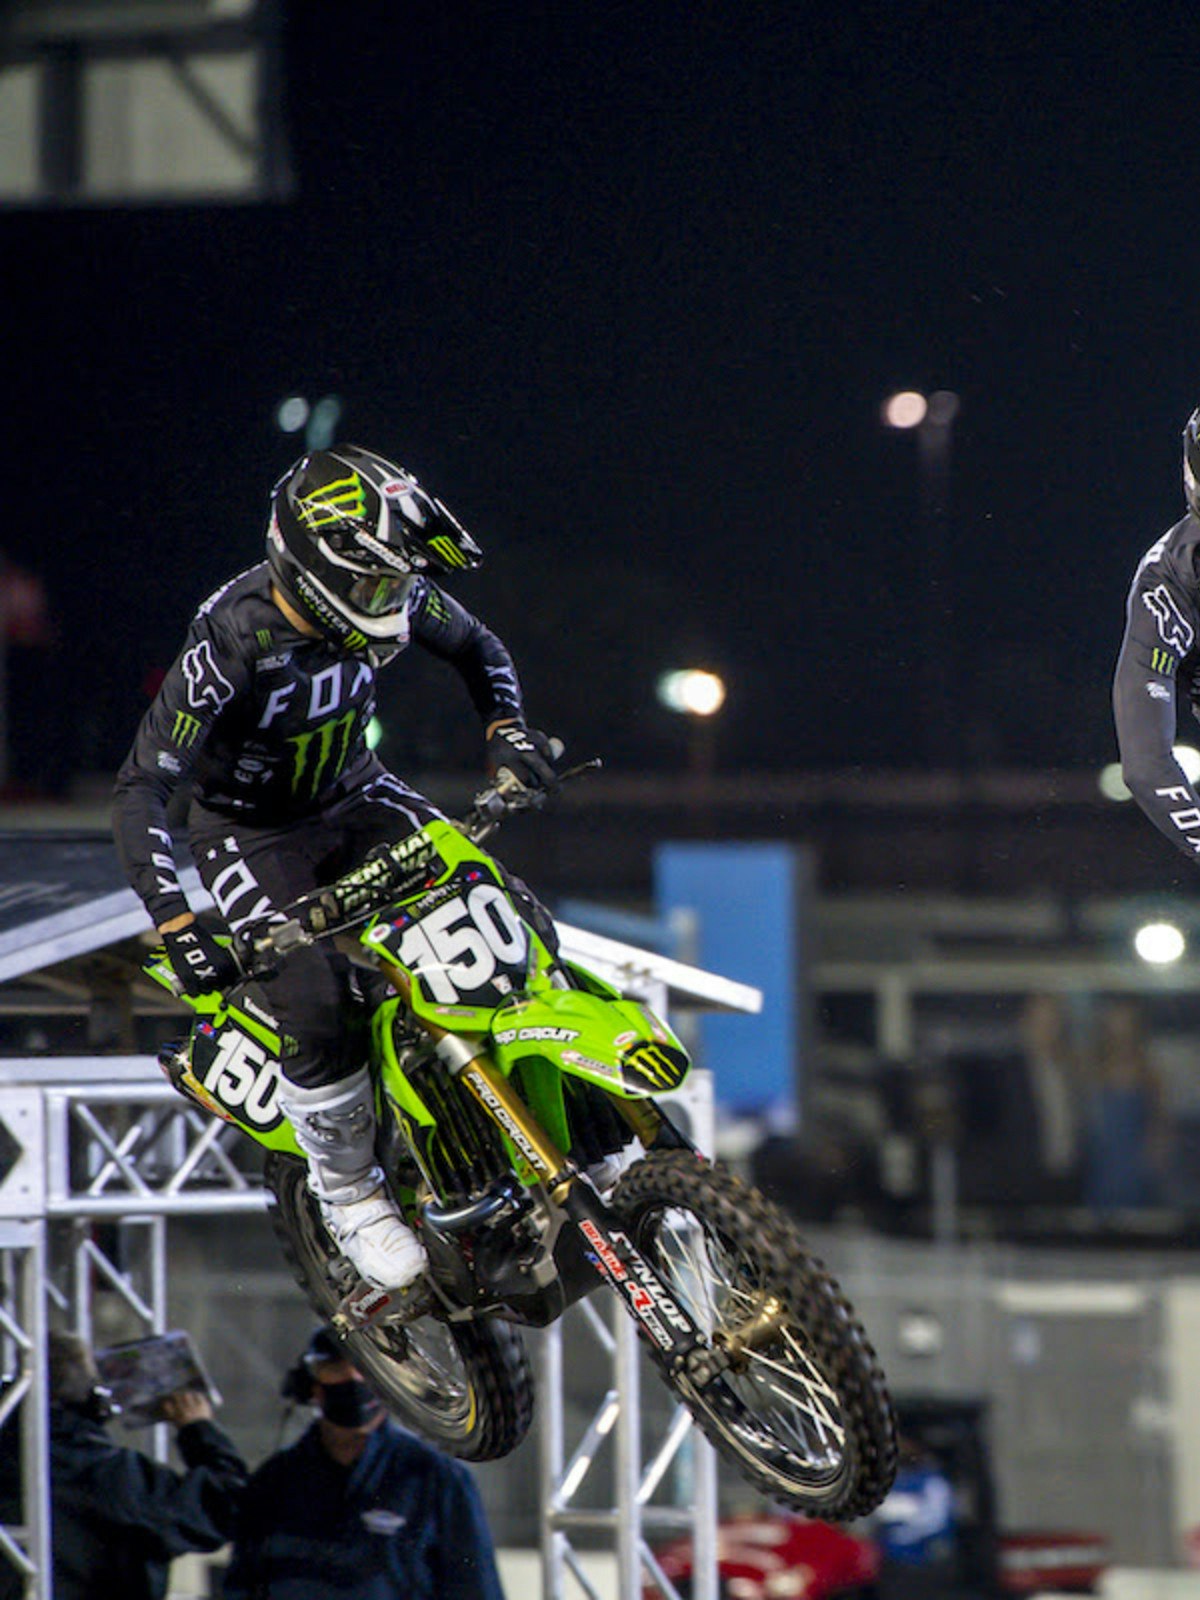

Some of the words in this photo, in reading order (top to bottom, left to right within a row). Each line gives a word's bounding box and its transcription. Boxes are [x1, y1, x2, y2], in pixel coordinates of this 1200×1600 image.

[176, 932, 217, 980] FOX
[398, 883, 527, 1004] 150
[203, 1029, 281, 1124] 150
[518, 1027, 580, 1043] CIRCUIT
[467, 1071, 497, 1108] PRO
[494, 1103, 549, 1171] CIRCUIT
[608, 1231, 692, 1333] NLOP
